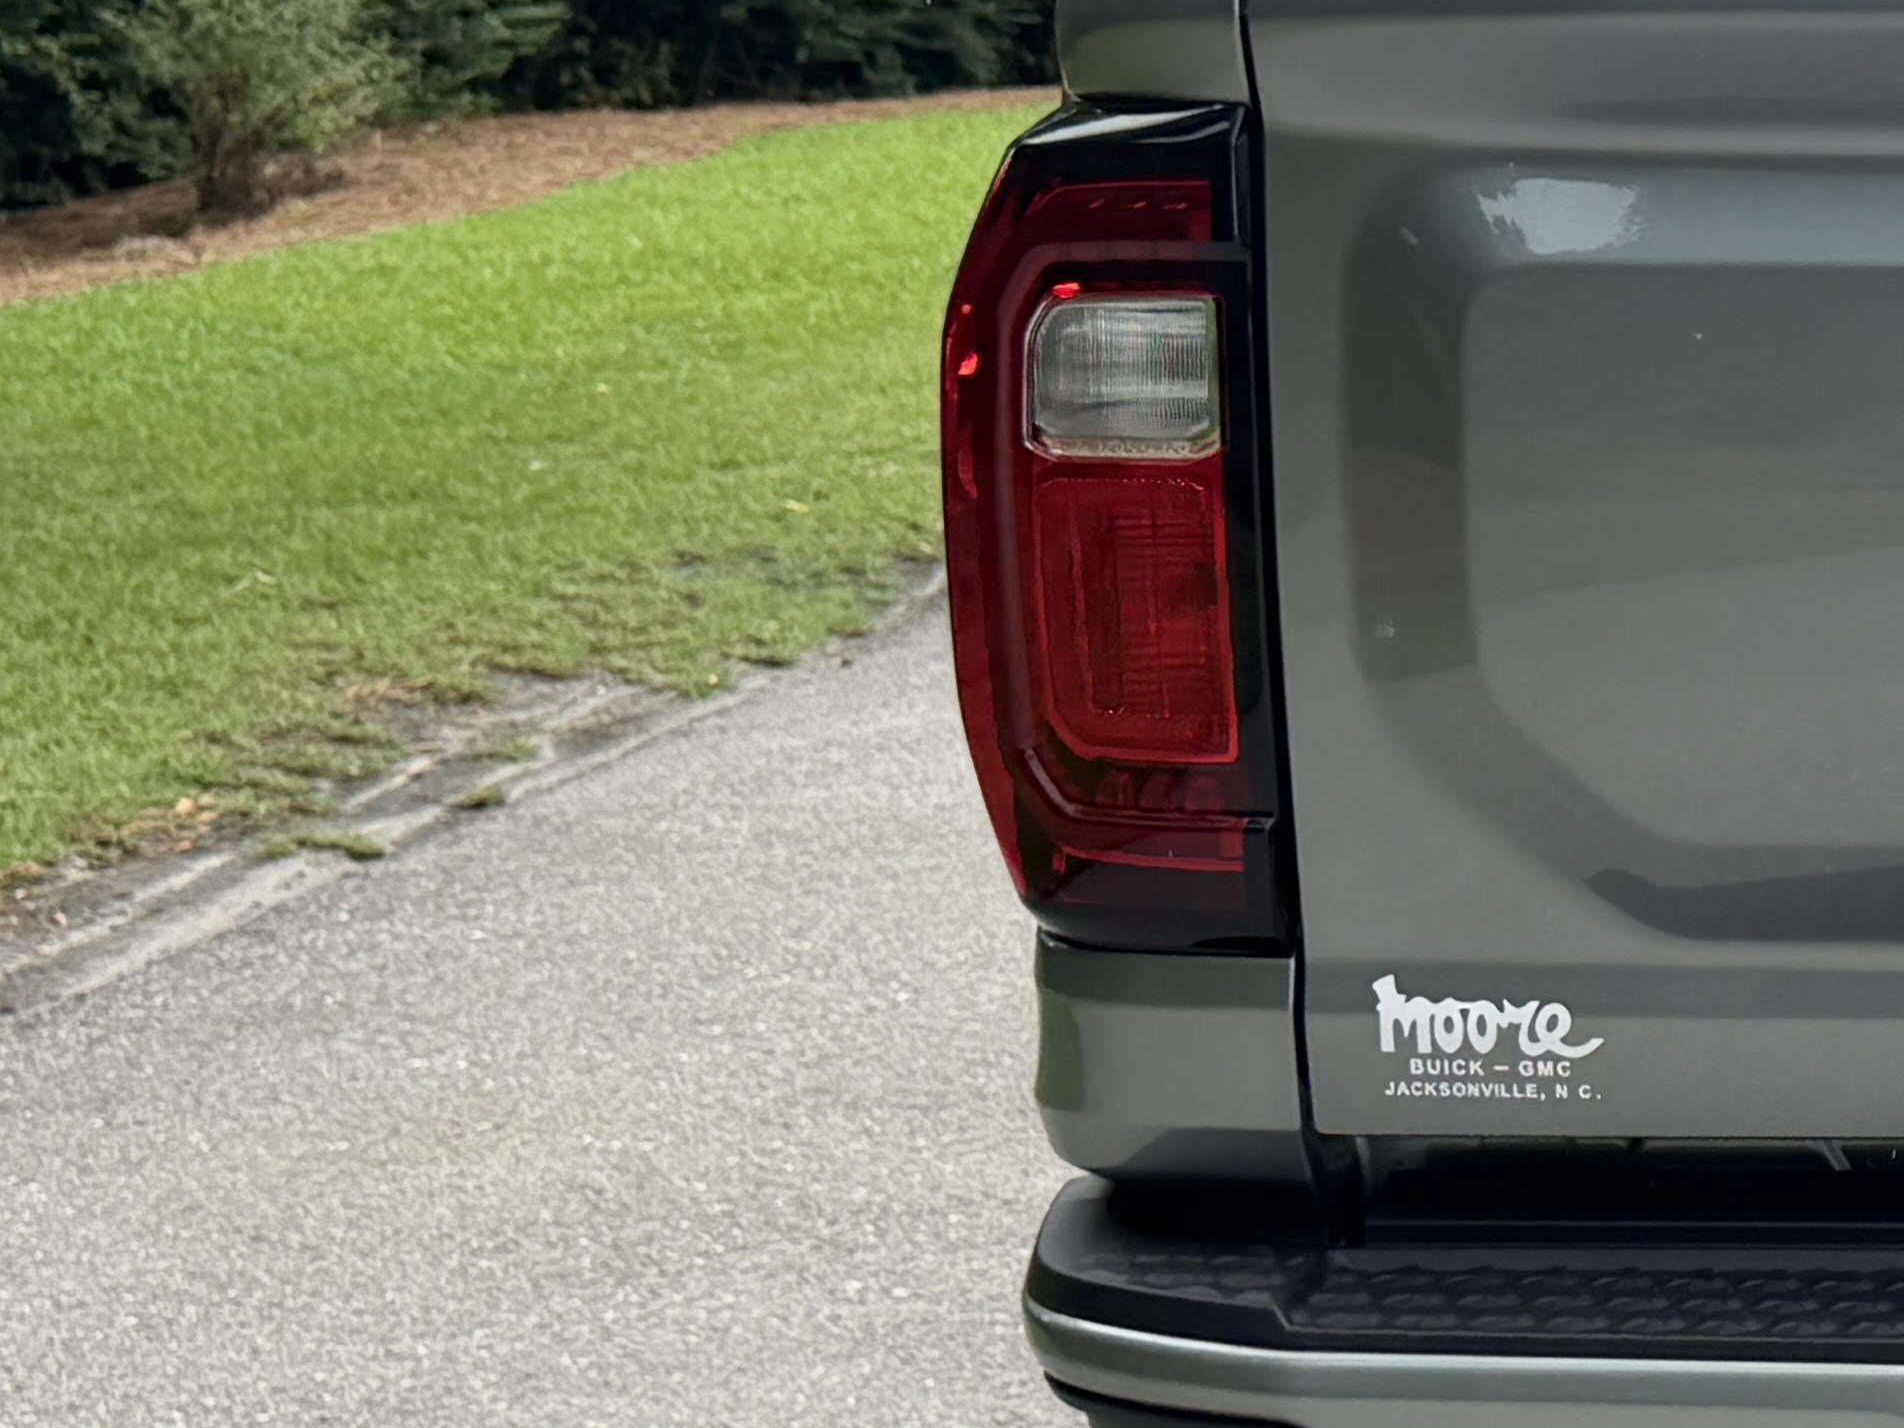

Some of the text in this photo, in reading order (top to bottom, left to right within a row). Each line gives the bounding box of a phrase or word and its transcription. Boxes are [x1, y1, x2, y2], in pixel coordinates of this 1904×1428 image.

[1409, 1058, 1485, 1077] BUICK
[1517, 1059, 1572, 1078] GMC
[1384, 1080, 1547, 1102] JACKSONVILLE,
